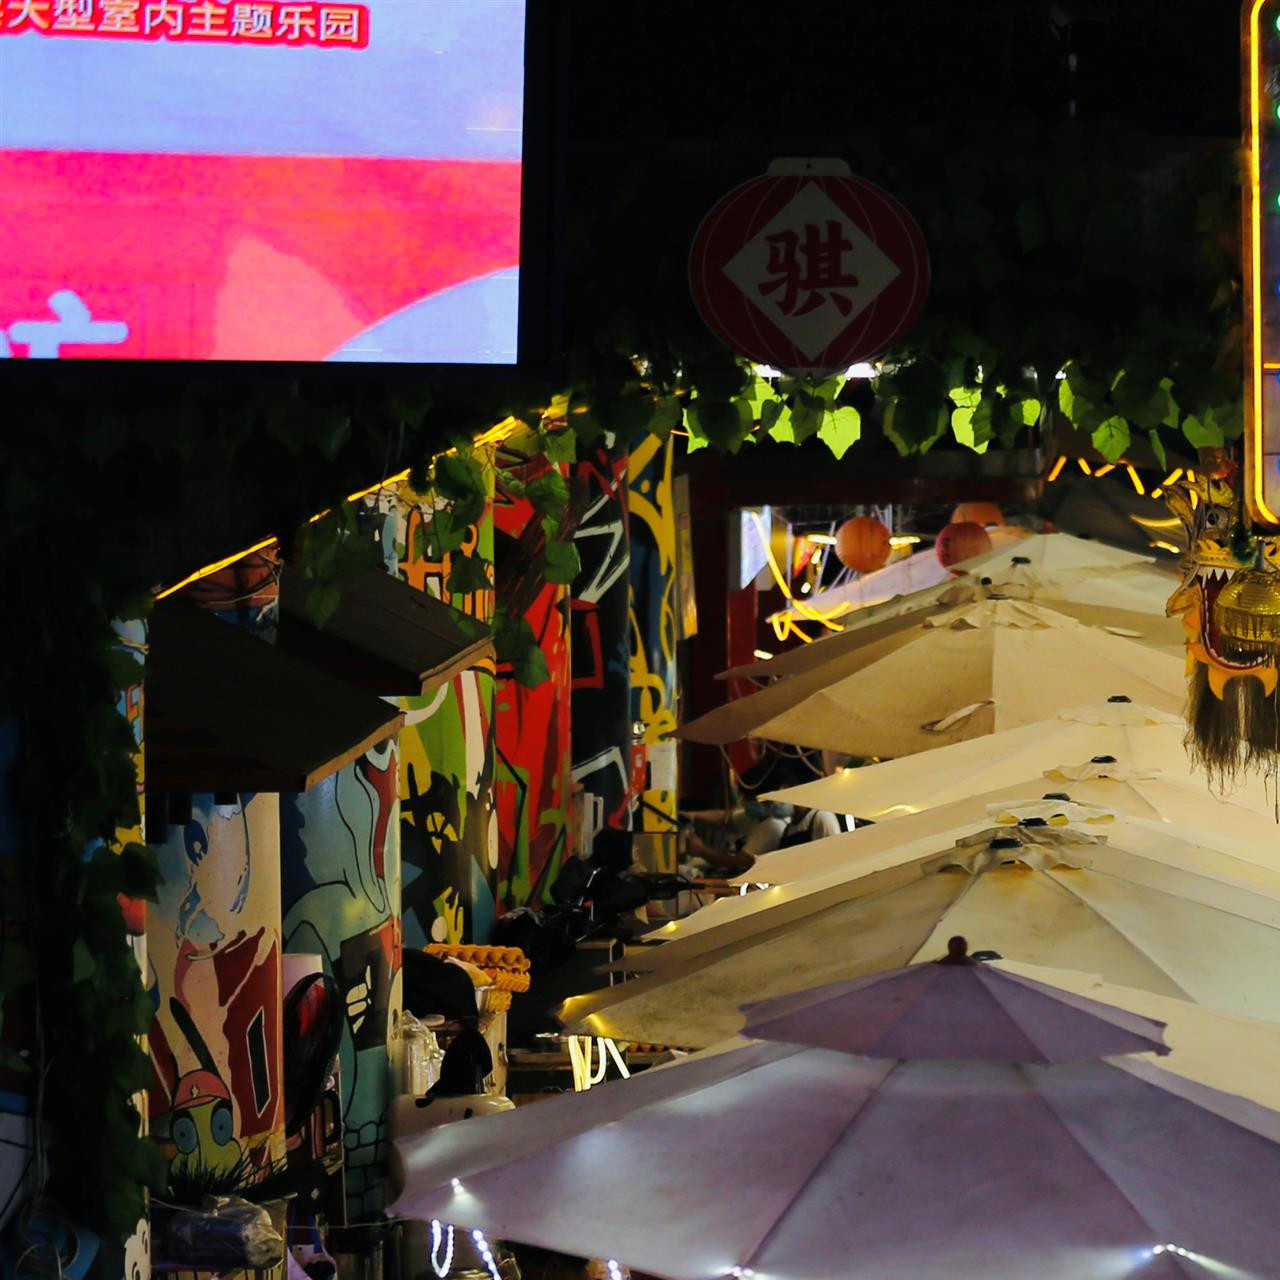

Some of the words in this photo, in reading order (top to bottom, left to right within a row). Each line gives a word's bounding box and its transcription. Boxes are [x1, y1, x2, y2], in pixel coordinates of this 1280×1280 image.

[0, 0, 360, 42] 大型室内主题乐园
[758, 218, 858, 318] 骐
